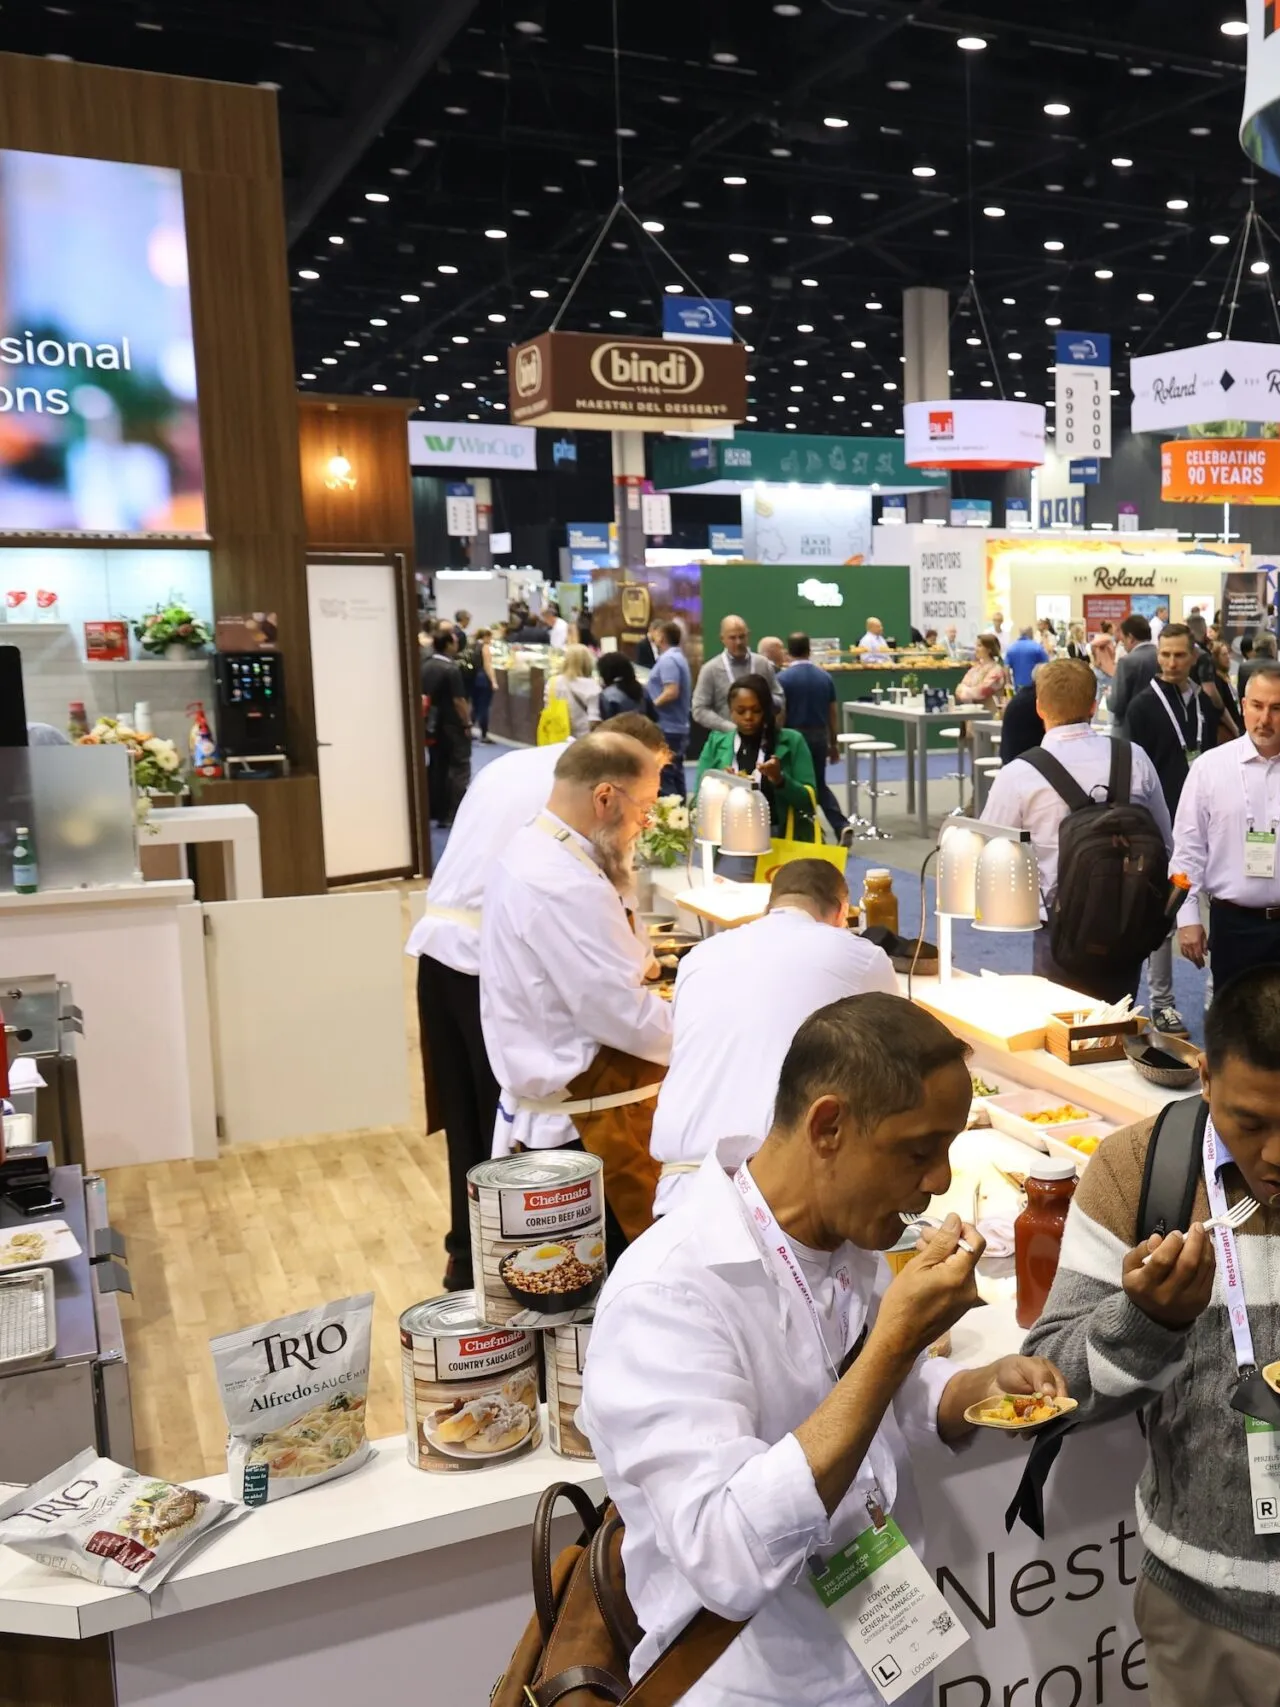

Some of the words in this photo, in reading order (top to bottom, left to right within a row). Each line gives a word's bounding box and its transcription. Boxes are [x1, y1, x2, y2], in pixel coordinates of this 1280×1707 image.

[610, 349, 687, 386] bindi
[1152, 373, 1198, 405] Roland
[575, 399, 634, 412] MAESTRI
[636, 402, 662, 413] DEL
[1186, 450, 1266, 466] CELEBRATING
[1187, 469, 1204, 486] 90
[1210, 467, 1264, 486] YEARS
[921, 552, 962, 570] PURVEYORS
[922, 577, 930, 594] OF
[931, 576, 948, 594] FINE
[1094, 566, 1157, 591] Roland
[922, 600, 966, 618] INGREDIENTS
[529, 1189, 589, 1208] Chef-mate
[525, 1215, 557, 1228] CORNED
[558, 1211, 575, 1223] BEEF
[576, 1205, 592, 1218] HASH
[252, 1322, 348, 1375] TRIO
[448, 1359, 484, 1372] COUNTRY
[485, 1351, 517, 1367] SAUSAGE
[517, 1342, 532, 1358] GRAVY
[249, 1384, 312, 1413] Alfredo
[313, 1372, 353, 1394] SAUCE
[1260, 1501, 1273, 1516] R
[858, 1602, 884, 1625] EDWIN
[883, 1580, 911, 1605] TORRES
[867, 1583, 890, 1605] EDWIN
[860, 1612, 890, 1637] GENERAL
[889, 1587, 920, 1614] MANAGER
[878, 1666, 895, 1681] L
[911, 1651, 940, 1677] LODGING
